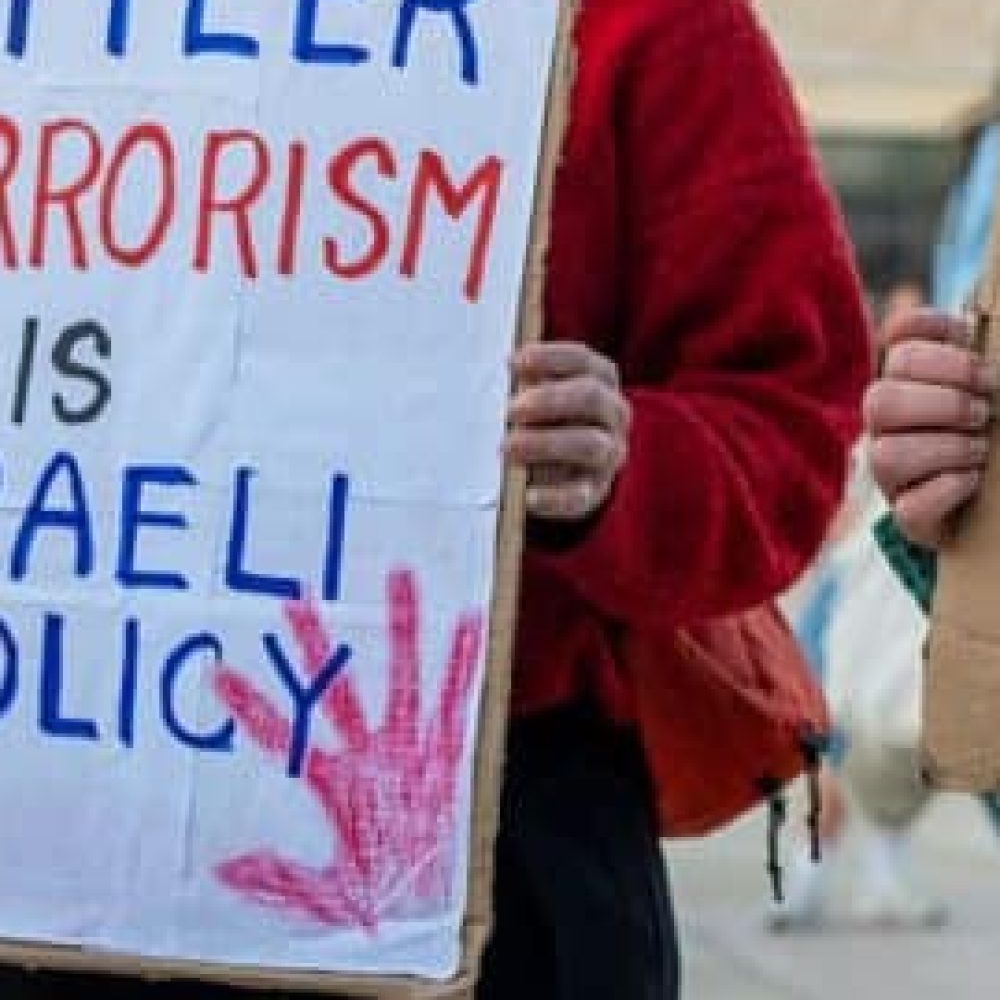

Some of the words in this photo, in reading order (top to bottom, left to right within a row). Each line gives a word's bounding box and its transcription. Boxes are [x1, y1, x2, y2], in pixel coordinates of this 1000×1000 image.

[10, 317, 112, 424] IS
[0, 450, 350, 601] AELI
[0, 610, 353, 779] LICY
